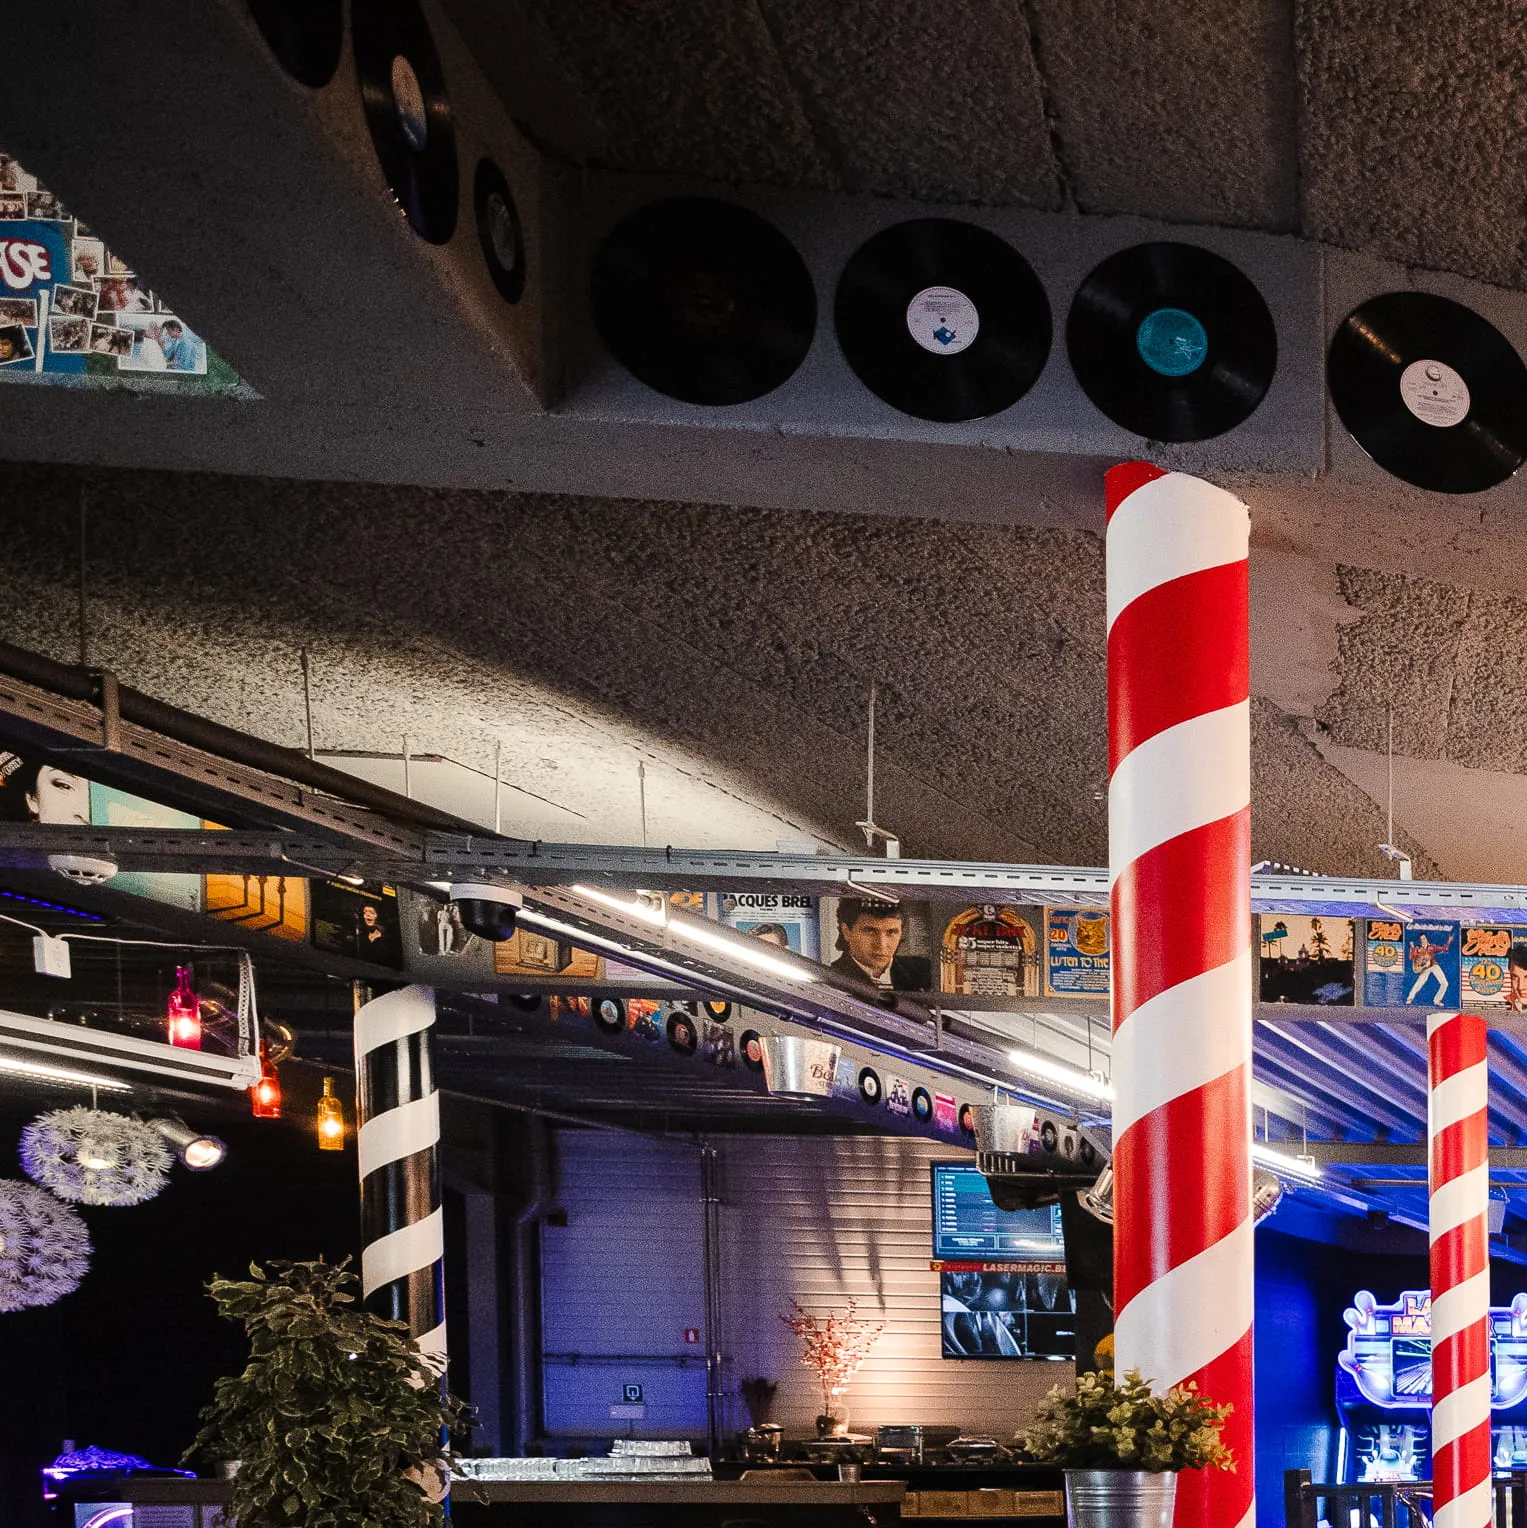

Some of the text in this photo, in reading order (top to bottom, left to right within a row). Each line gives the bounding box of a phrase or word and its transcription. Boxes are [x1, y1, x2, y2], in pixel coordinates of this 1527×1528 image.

[1050, 929, 1067, 941] 20
[1375, 946, 1395, 957] 40
[1472, 964, 1501, 981] 40
[982, 1263, 1067, 1273] LASERMAGIC.BE
